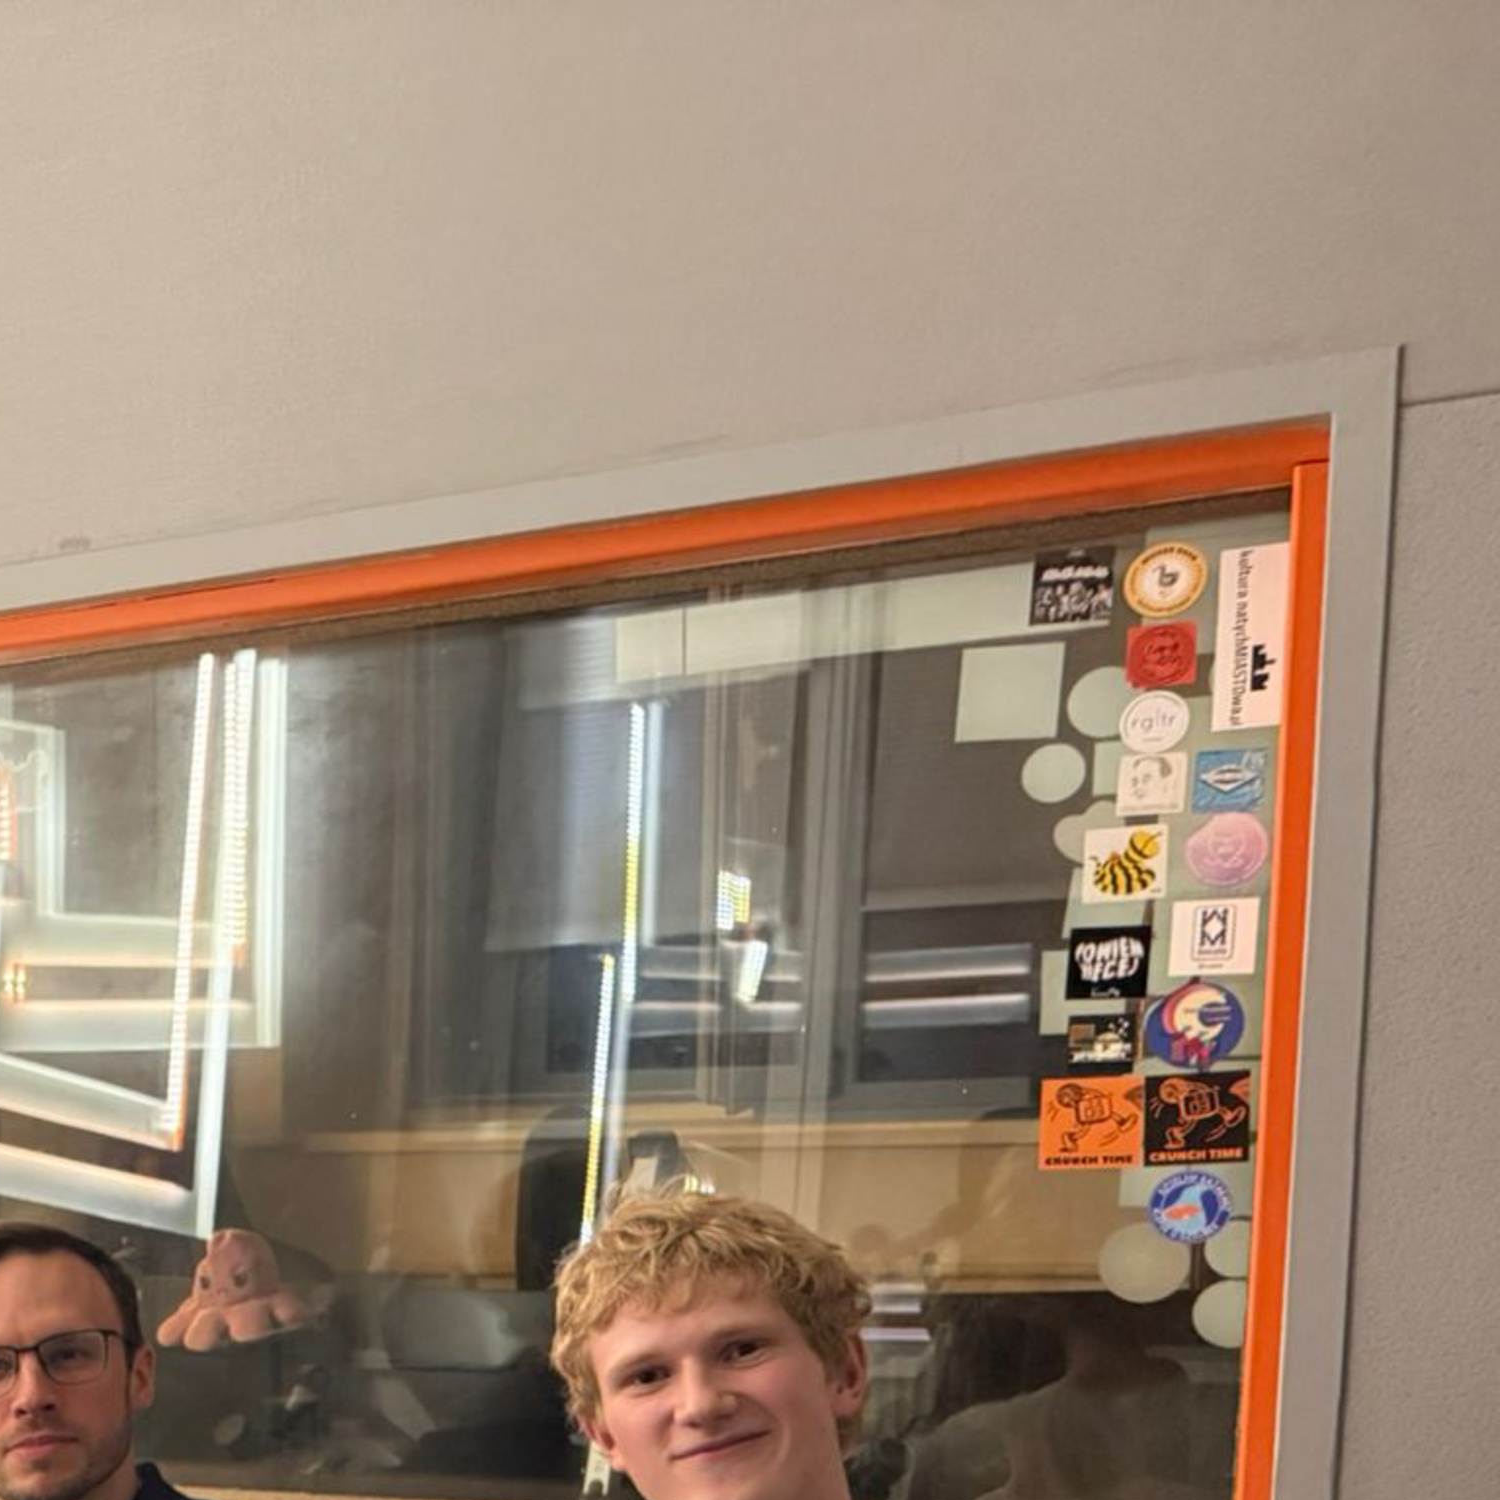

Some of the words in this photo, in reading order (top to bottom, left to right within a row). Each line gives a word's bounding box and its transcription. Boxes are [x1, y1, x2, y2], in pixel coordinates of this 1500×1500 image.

[1237, 550, 1254, 598] kultura
[1045, 1156, 1099, 1166] CRUNCH
[1102, 1154, 1133, 1165] TIME
[1149, 1149, 1208, 1163] CRUNCH
[1210, 1147, 1244, 1160] TIME
